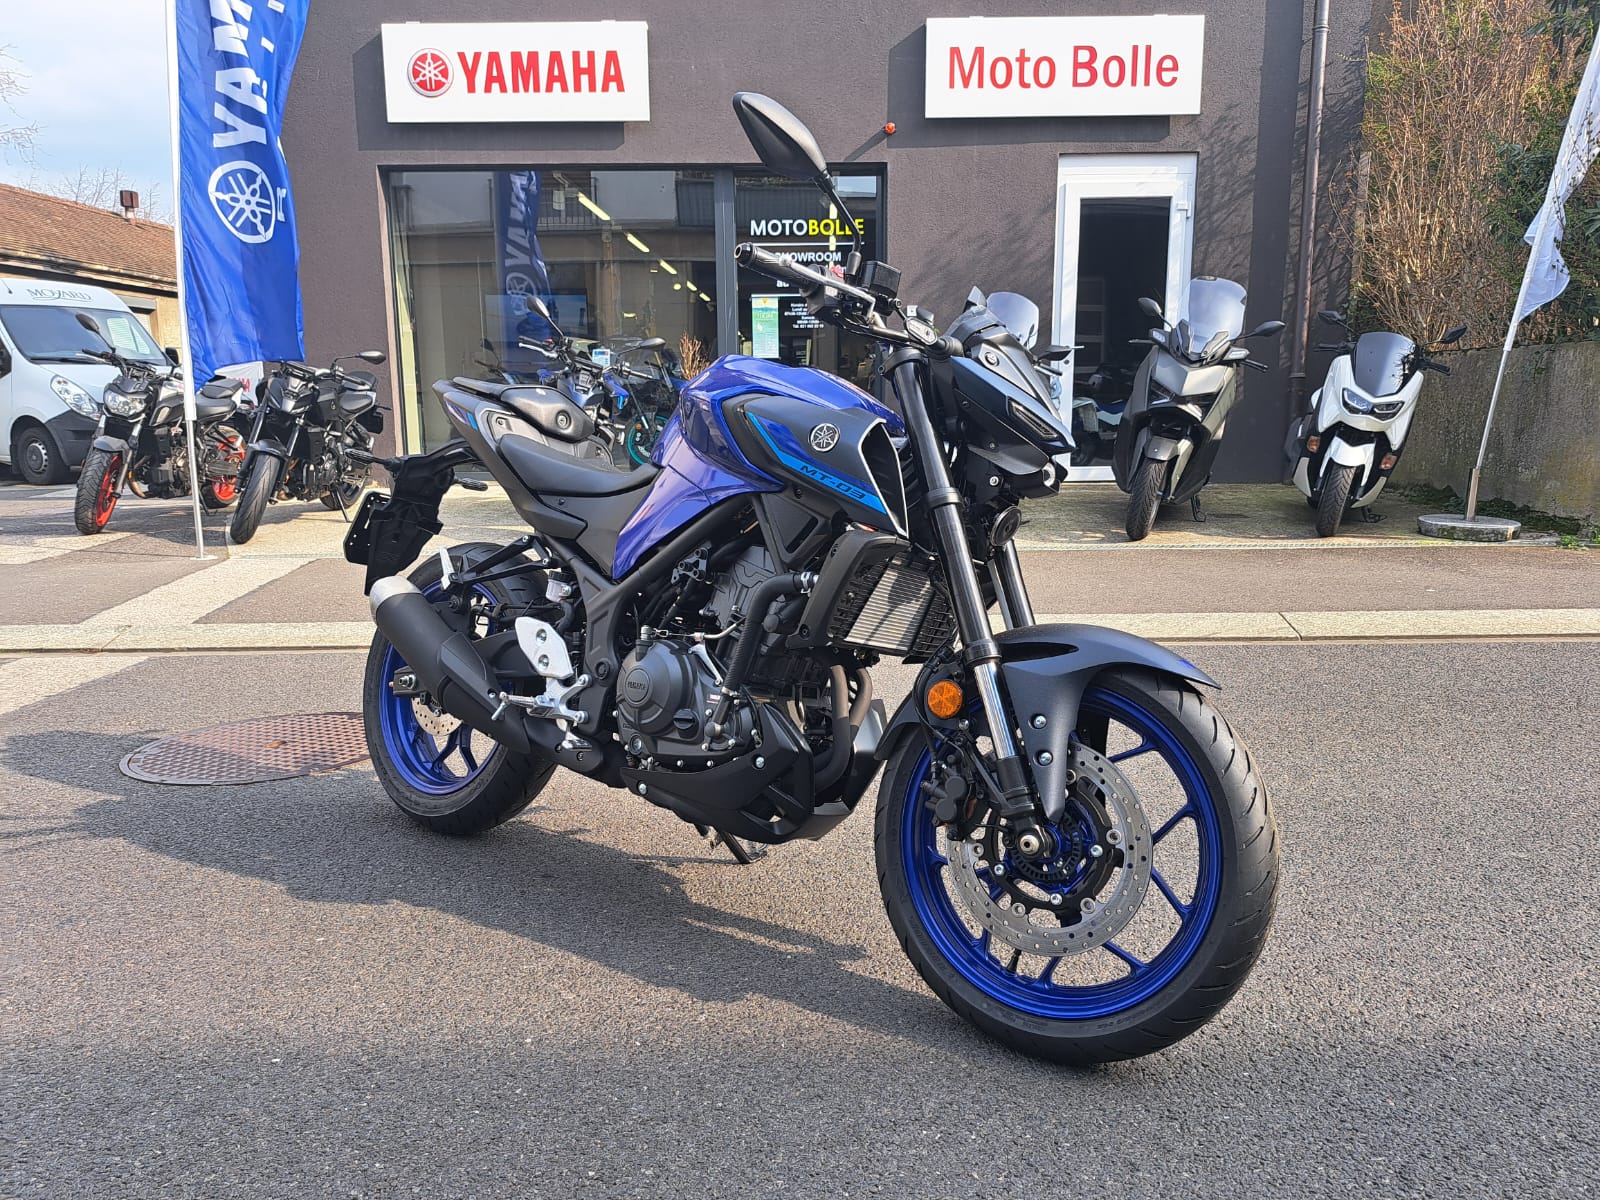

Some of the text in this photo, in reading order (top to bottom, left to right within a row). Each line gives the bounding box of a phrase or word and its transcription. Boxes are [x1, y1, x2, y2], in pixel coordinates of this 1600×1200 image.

[457, 50, 625, 93] YAMAHA
[949, 44, 1179, 89] Moto Bolle
[800, 465, 866, 500] MT-03
